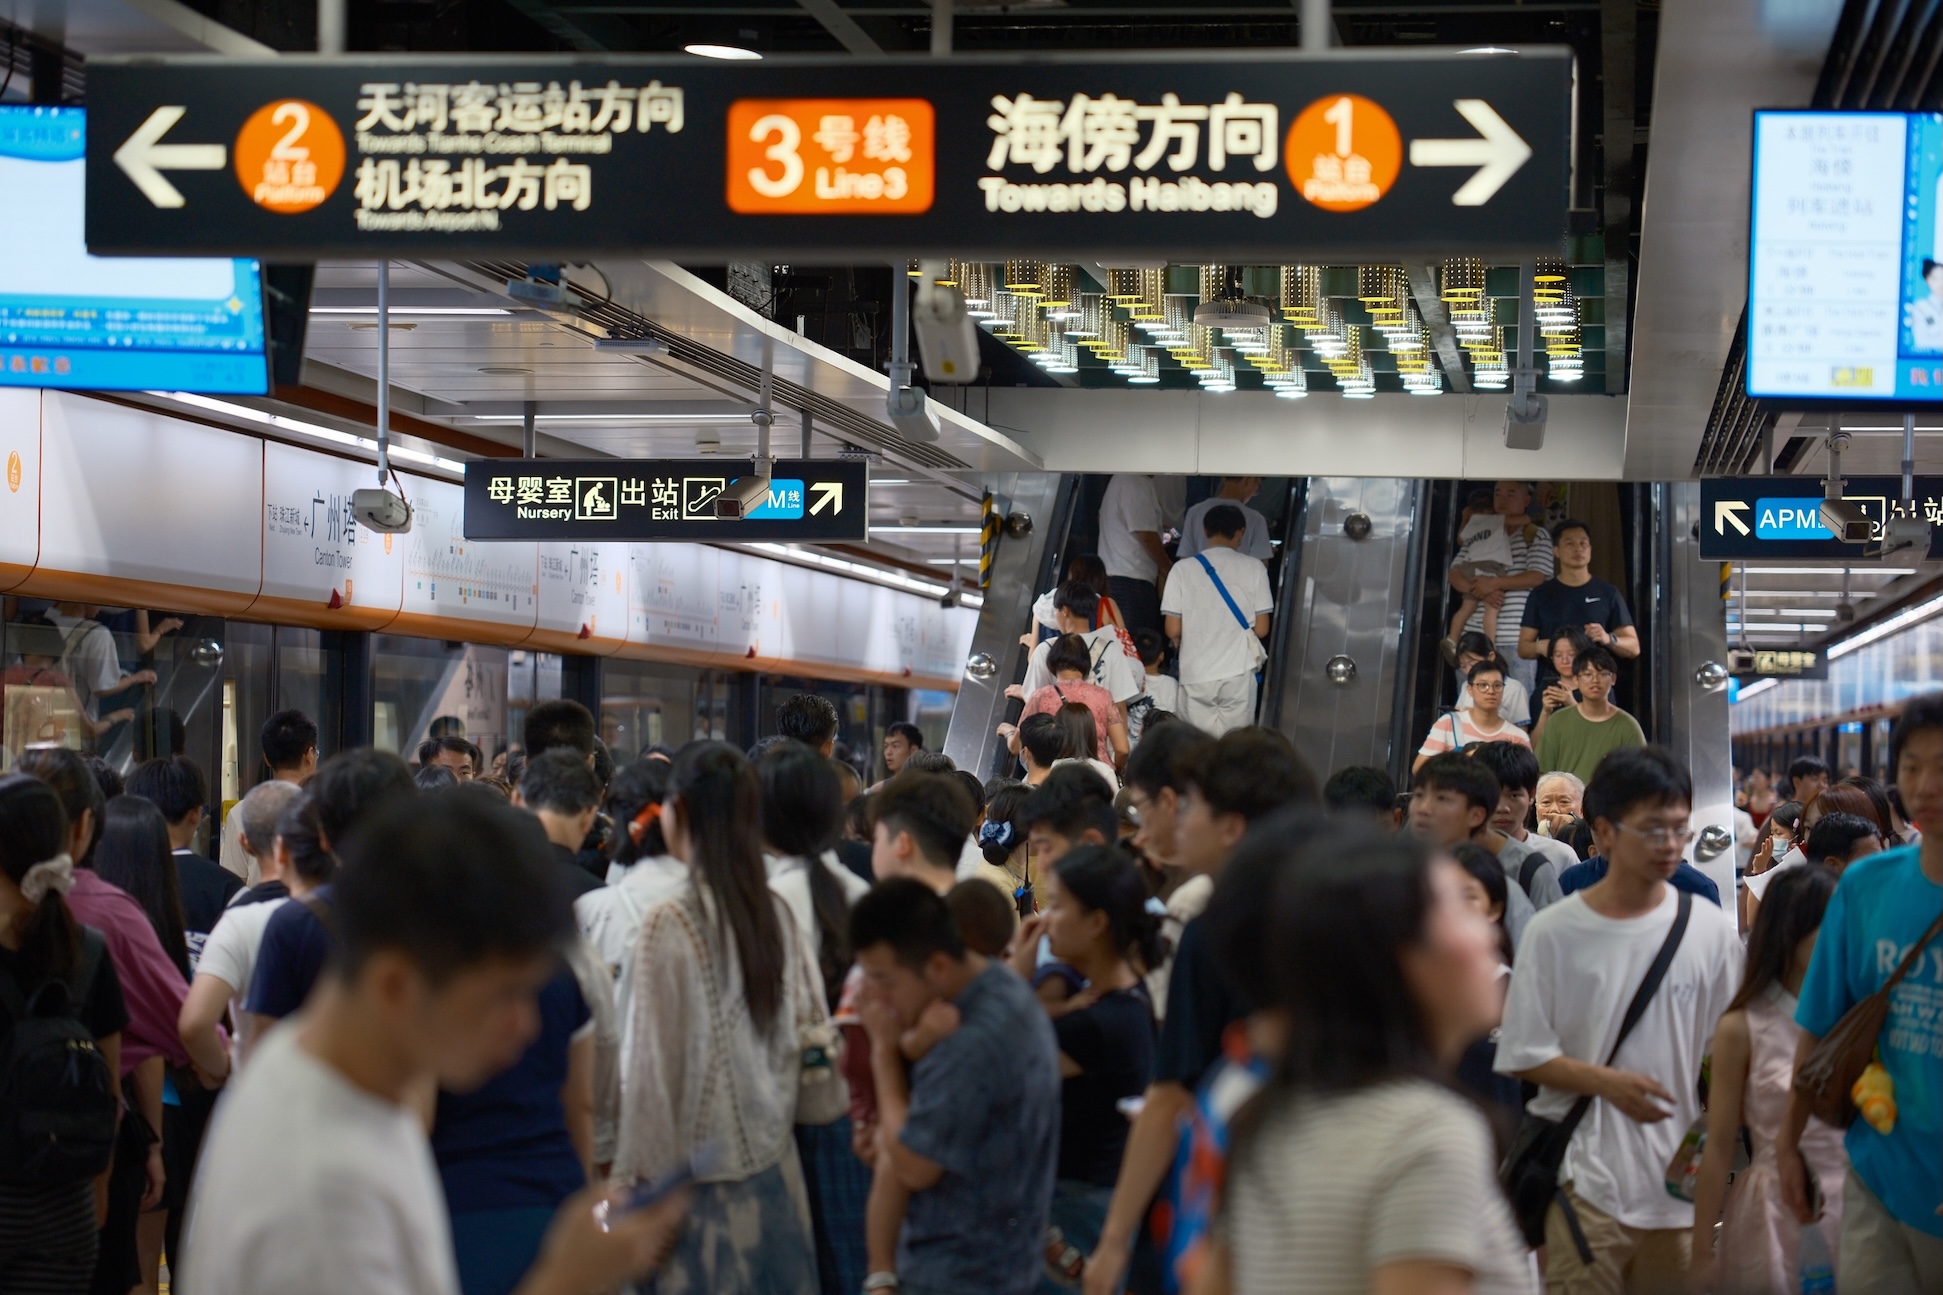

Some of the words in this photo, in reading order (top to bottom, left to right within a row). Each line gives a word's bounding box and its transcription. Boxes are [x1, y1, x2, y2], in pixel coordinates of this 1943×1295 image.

[271, 103, 310, 160] 2
[354, 80, 686, 133] 天河客运站方向
[987, 92, 1279, 173] 海傍方向
[1324, 97, 1353, 159] 1
[748, 114, 804, 198] 3
[812, 114, 912, 163] 号线
[354, 157, 591, 211] 机场北方向
[978, 177, 1126, 213] Towards
[1129, 176, 1278, 218] Haibang
[487, 475, 573, 505] 母婴室
[620, 477, 680, 507] 出站
[788, 490, 800, 502] 线
[517, 506, 572, 521] Nursery
[651, 507, 679, 520] Exit
[1760, 509, 1815, 528] APM
[315, 547, 335, 567] Canton
[336, 550, 353, 569] Tower
